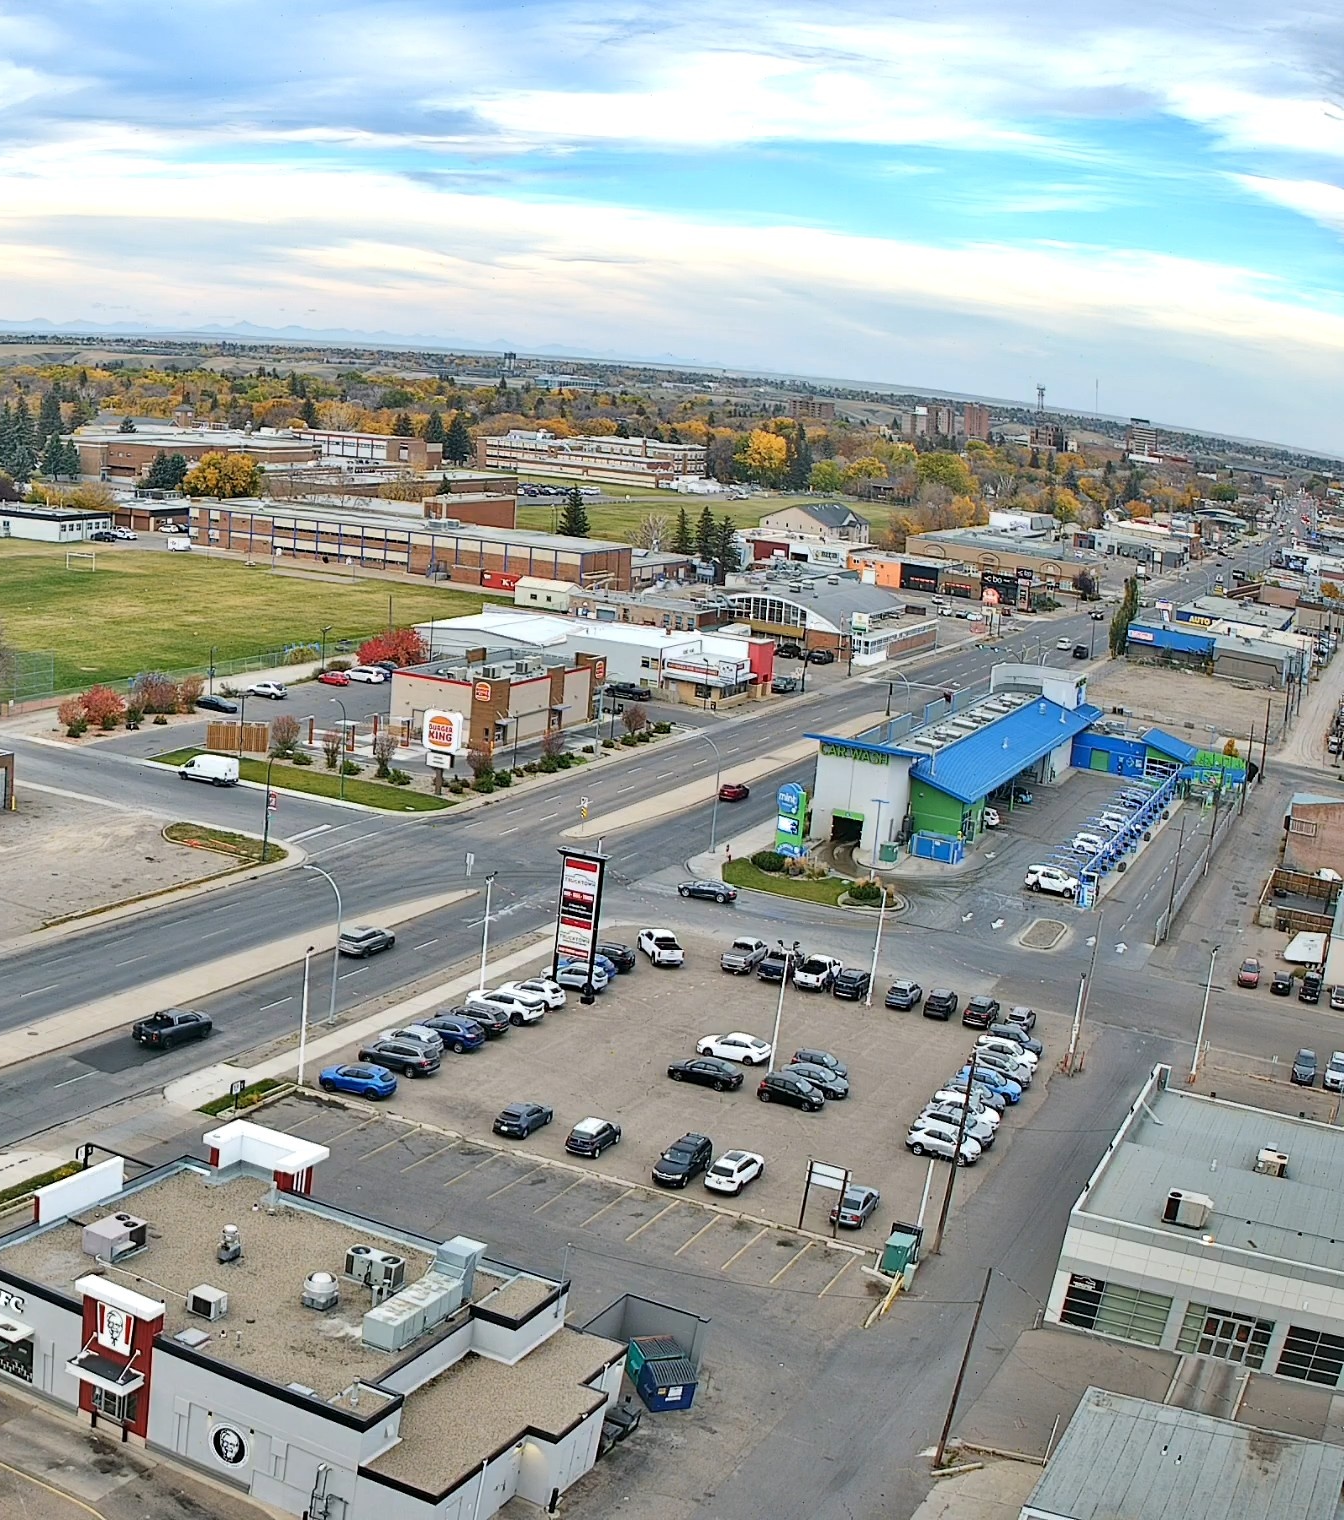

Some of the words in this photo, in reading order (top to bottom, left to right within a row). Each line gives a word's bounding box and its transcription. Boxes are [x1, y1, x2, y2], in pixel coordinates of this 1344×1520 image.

[428, 730, 453, 742] KING
[820, 743, 847, 758] CAR
[850, 747, 889, 766] WASH
[778, 792, 798, 805] mint
